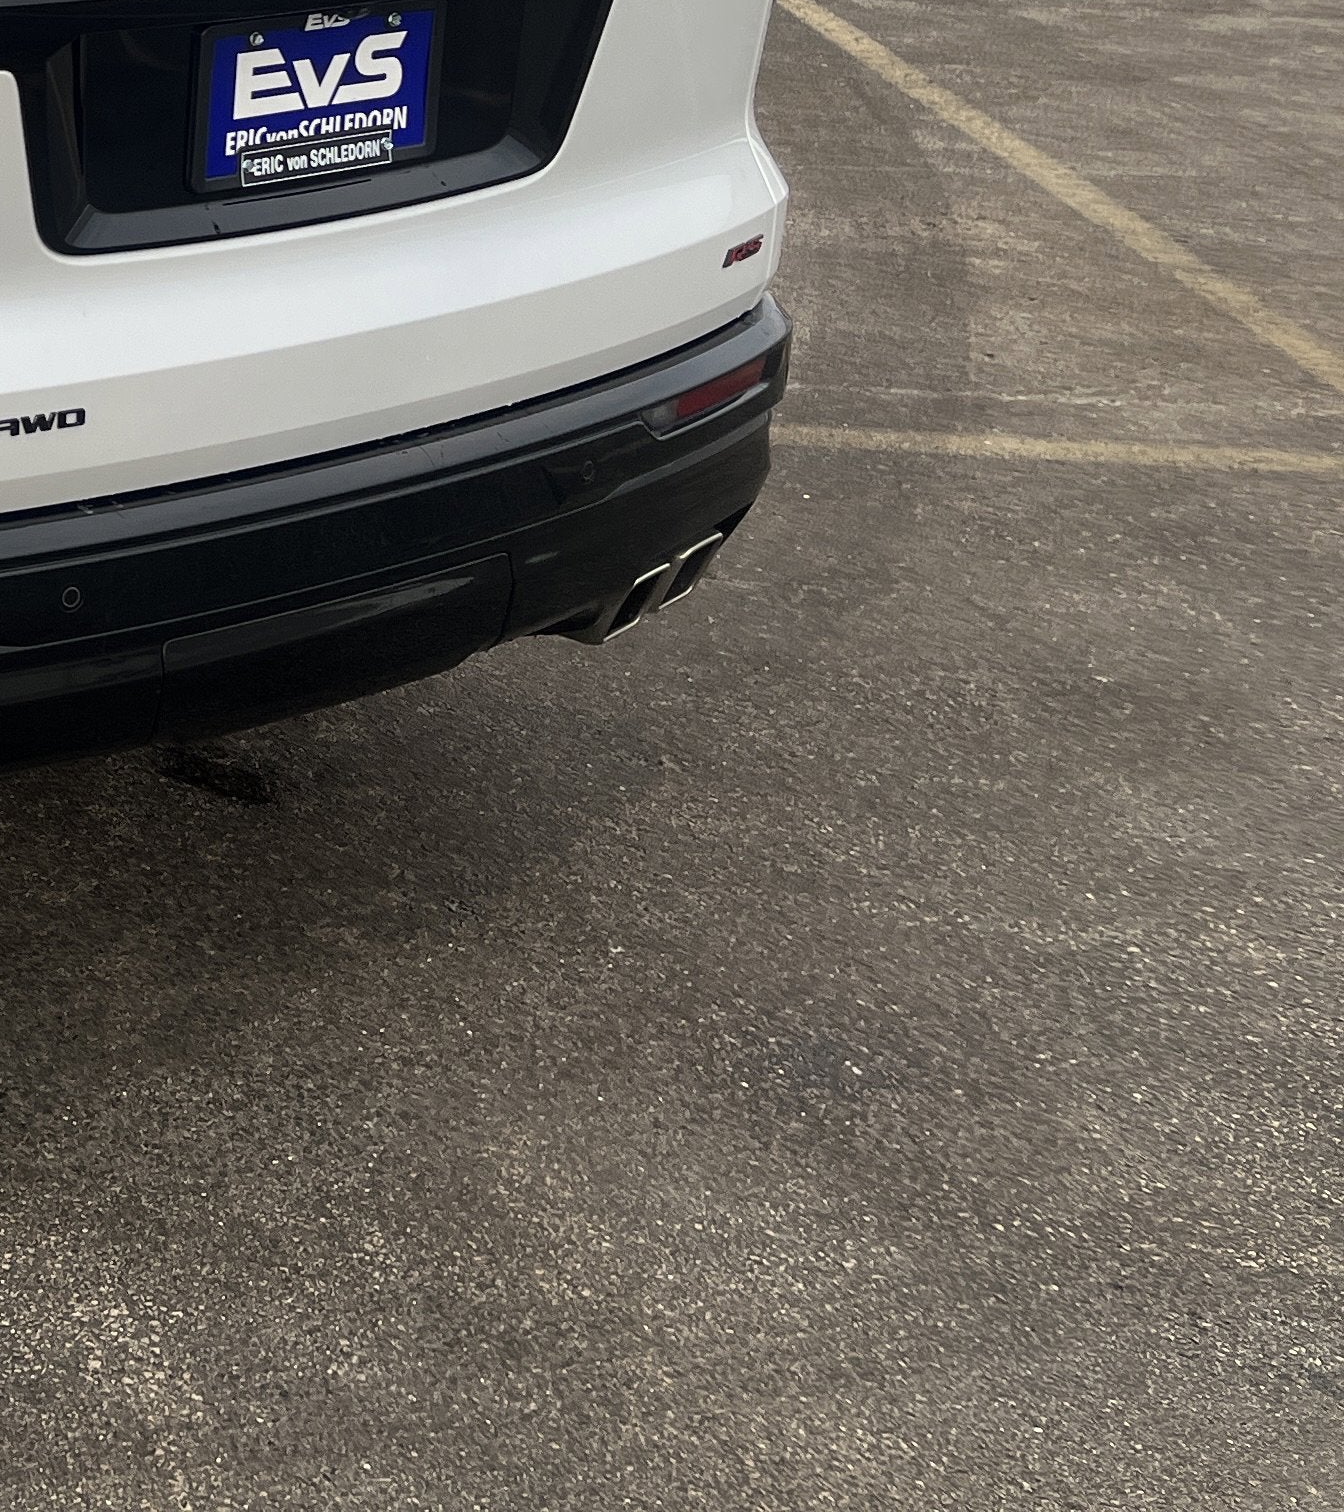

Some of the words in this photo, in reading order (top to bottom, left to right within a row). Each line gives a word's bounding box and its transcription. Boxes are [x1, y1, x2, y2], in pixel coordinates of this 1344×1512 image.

[253, 154, 284, 177] ERIC
[286, 154, 308, 171] von
[310, 139, 381, 167] SCHLEDORN
[722, 233, 764, 268] RS
